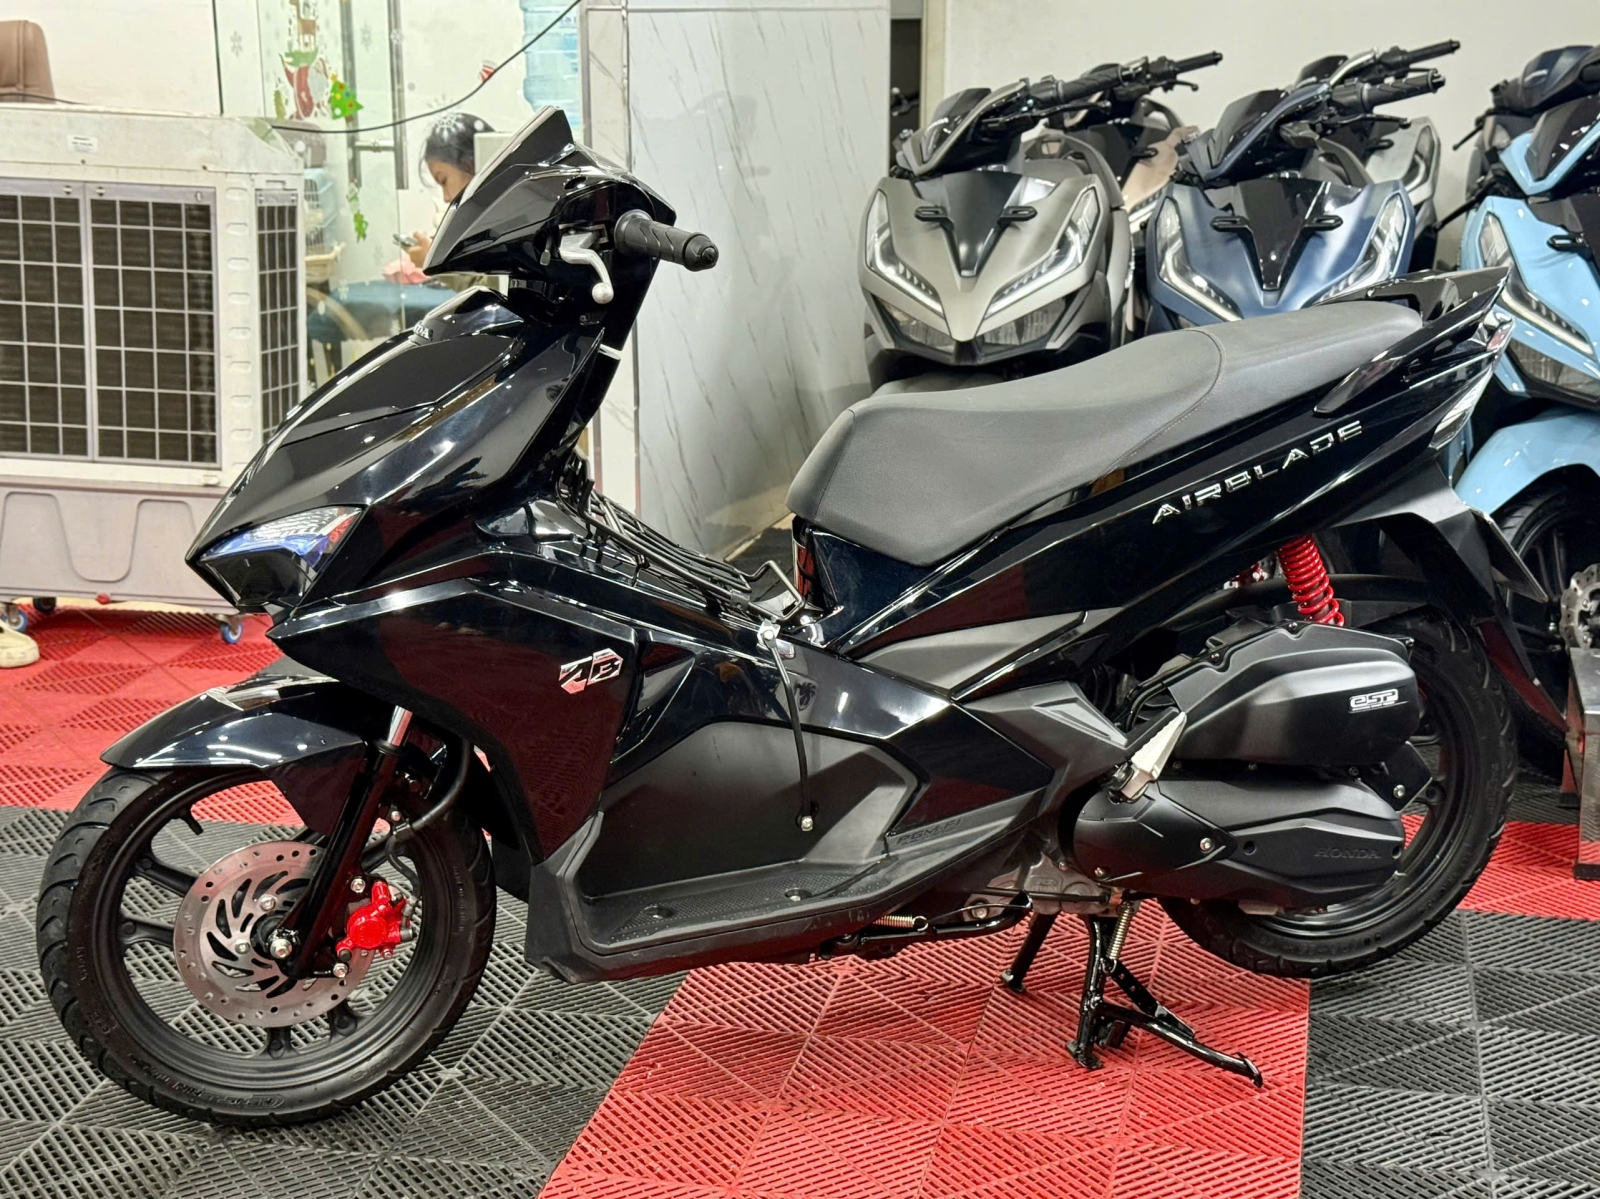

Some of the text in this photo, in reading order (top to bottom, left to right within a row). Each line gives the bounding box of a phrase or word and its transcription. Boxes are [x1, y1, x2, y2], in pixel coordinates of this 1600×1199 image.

[1152, 420, 1363, 524] AIRBLADE
[896, 817, 962, 845] PGM-FI
[1314, 846, 1382, 859] HONDA
